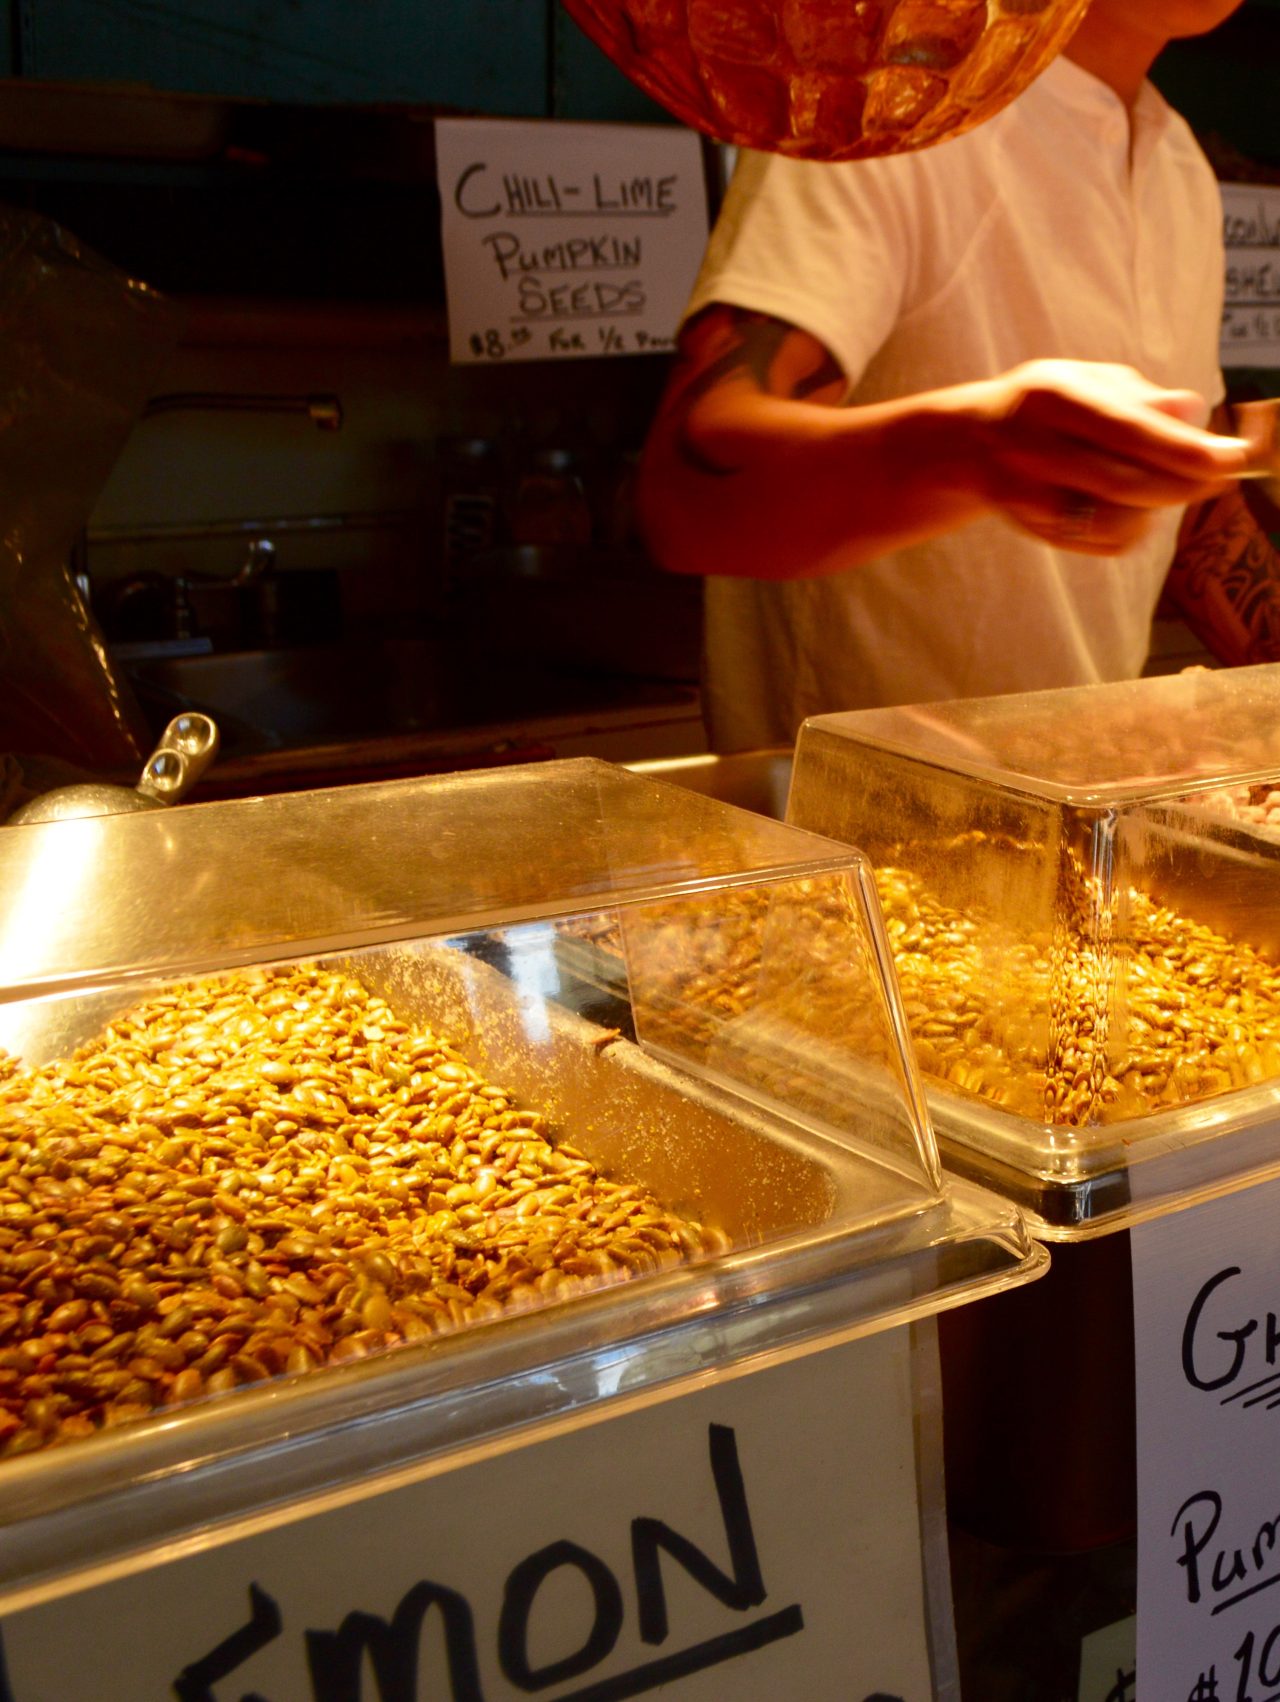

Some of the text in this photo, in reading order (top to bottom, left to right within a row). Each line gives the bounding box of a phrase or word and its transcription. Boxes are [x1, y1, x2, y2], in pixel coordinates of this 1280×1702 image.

[455, 162, 678, 220] CHILI-LIME
[482, 232, 642, 281] PUMPKIN
[518, 275, 647, 316] SEEDS
